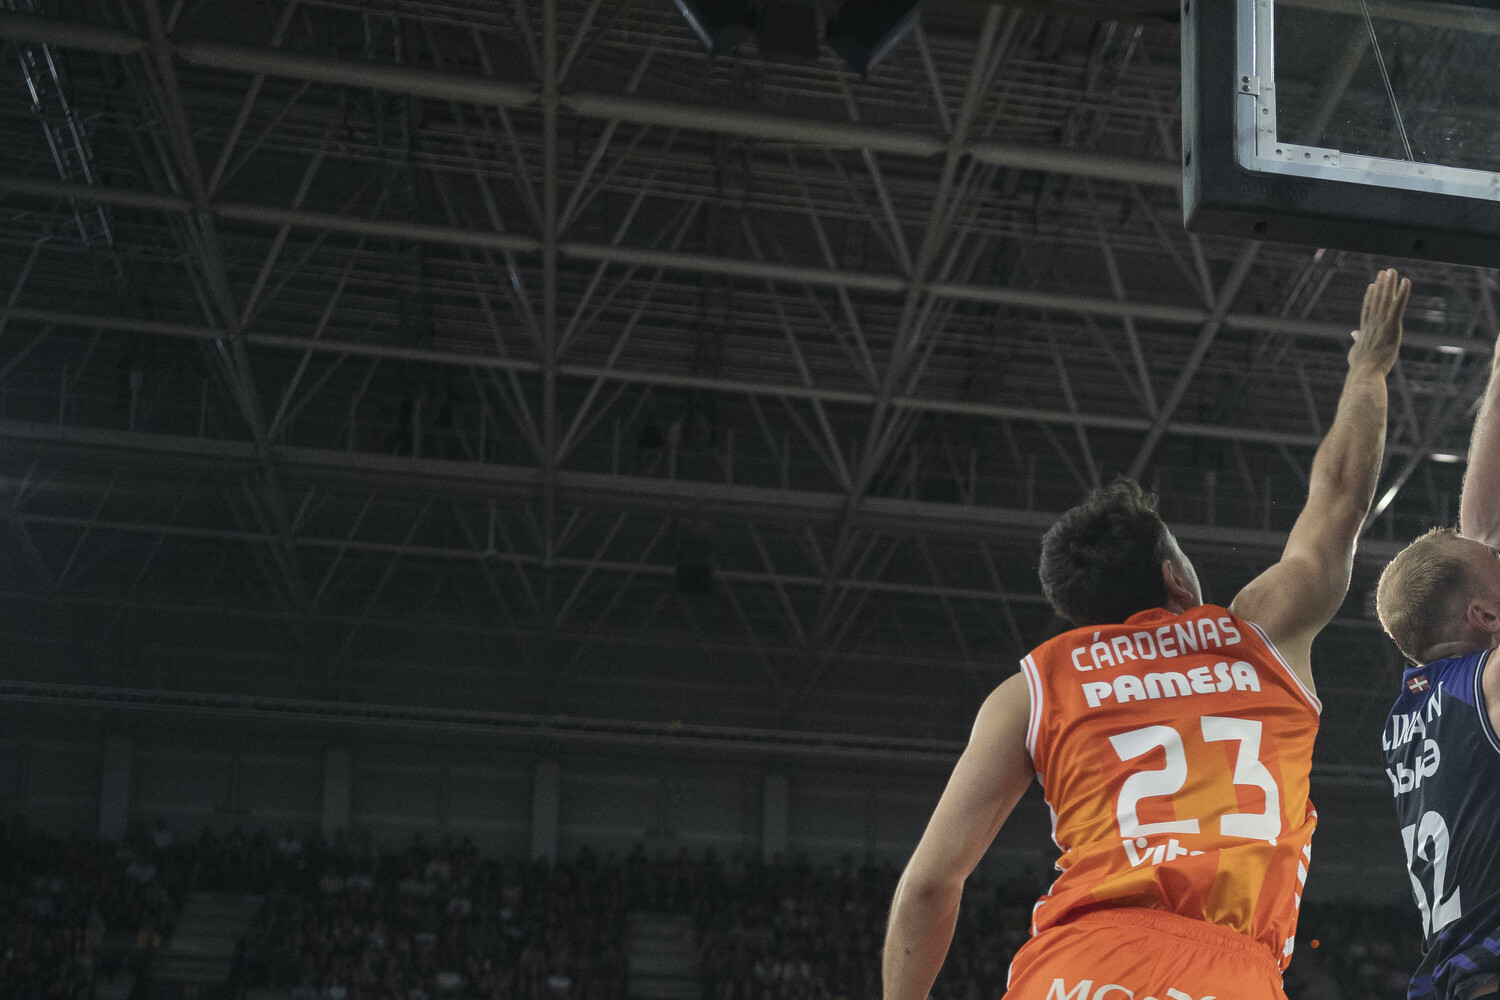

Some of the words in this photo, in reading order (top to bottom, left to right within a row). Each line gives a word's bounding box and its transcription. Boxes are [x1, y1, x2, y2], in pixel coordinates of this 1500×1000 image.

[1071, 617, 1242, 672] CÁRDENAS
[1082, 661, 1261, 708] PAMESA
[1109, 716, 1281, 840] 23
